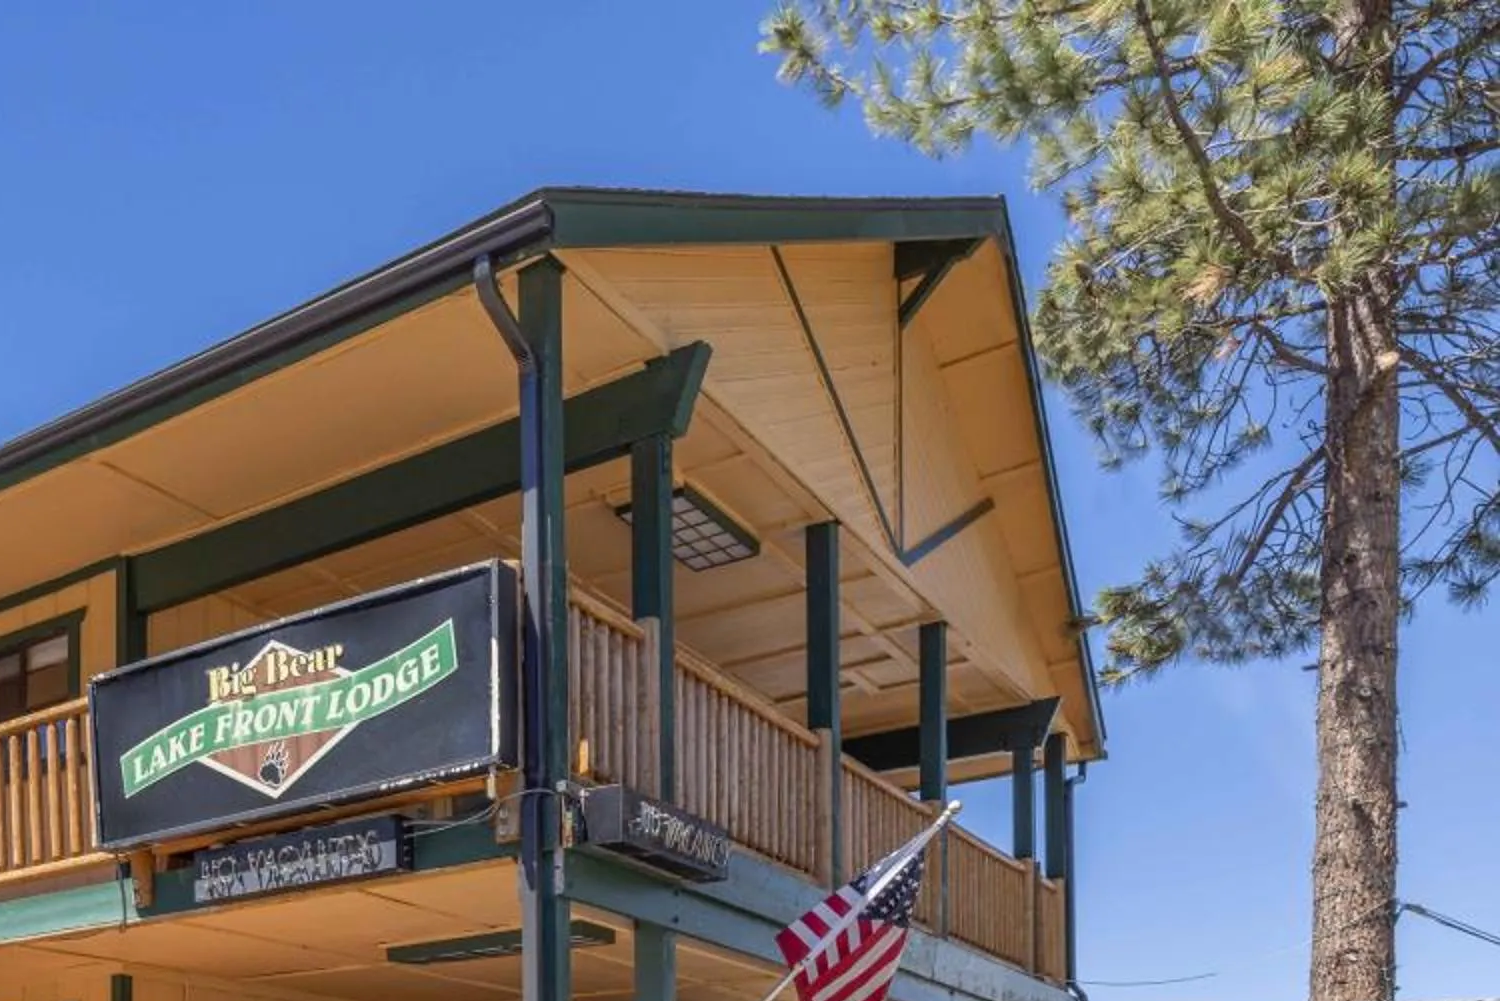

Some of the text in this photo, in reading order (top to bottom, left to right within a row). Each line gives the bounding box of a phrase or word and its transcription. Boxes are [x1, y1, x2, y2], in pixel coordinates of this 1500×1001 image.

[134, 643, 441, 785] LAKE FRONT LODGE
[206, 644, 343, 700] Big Bear
